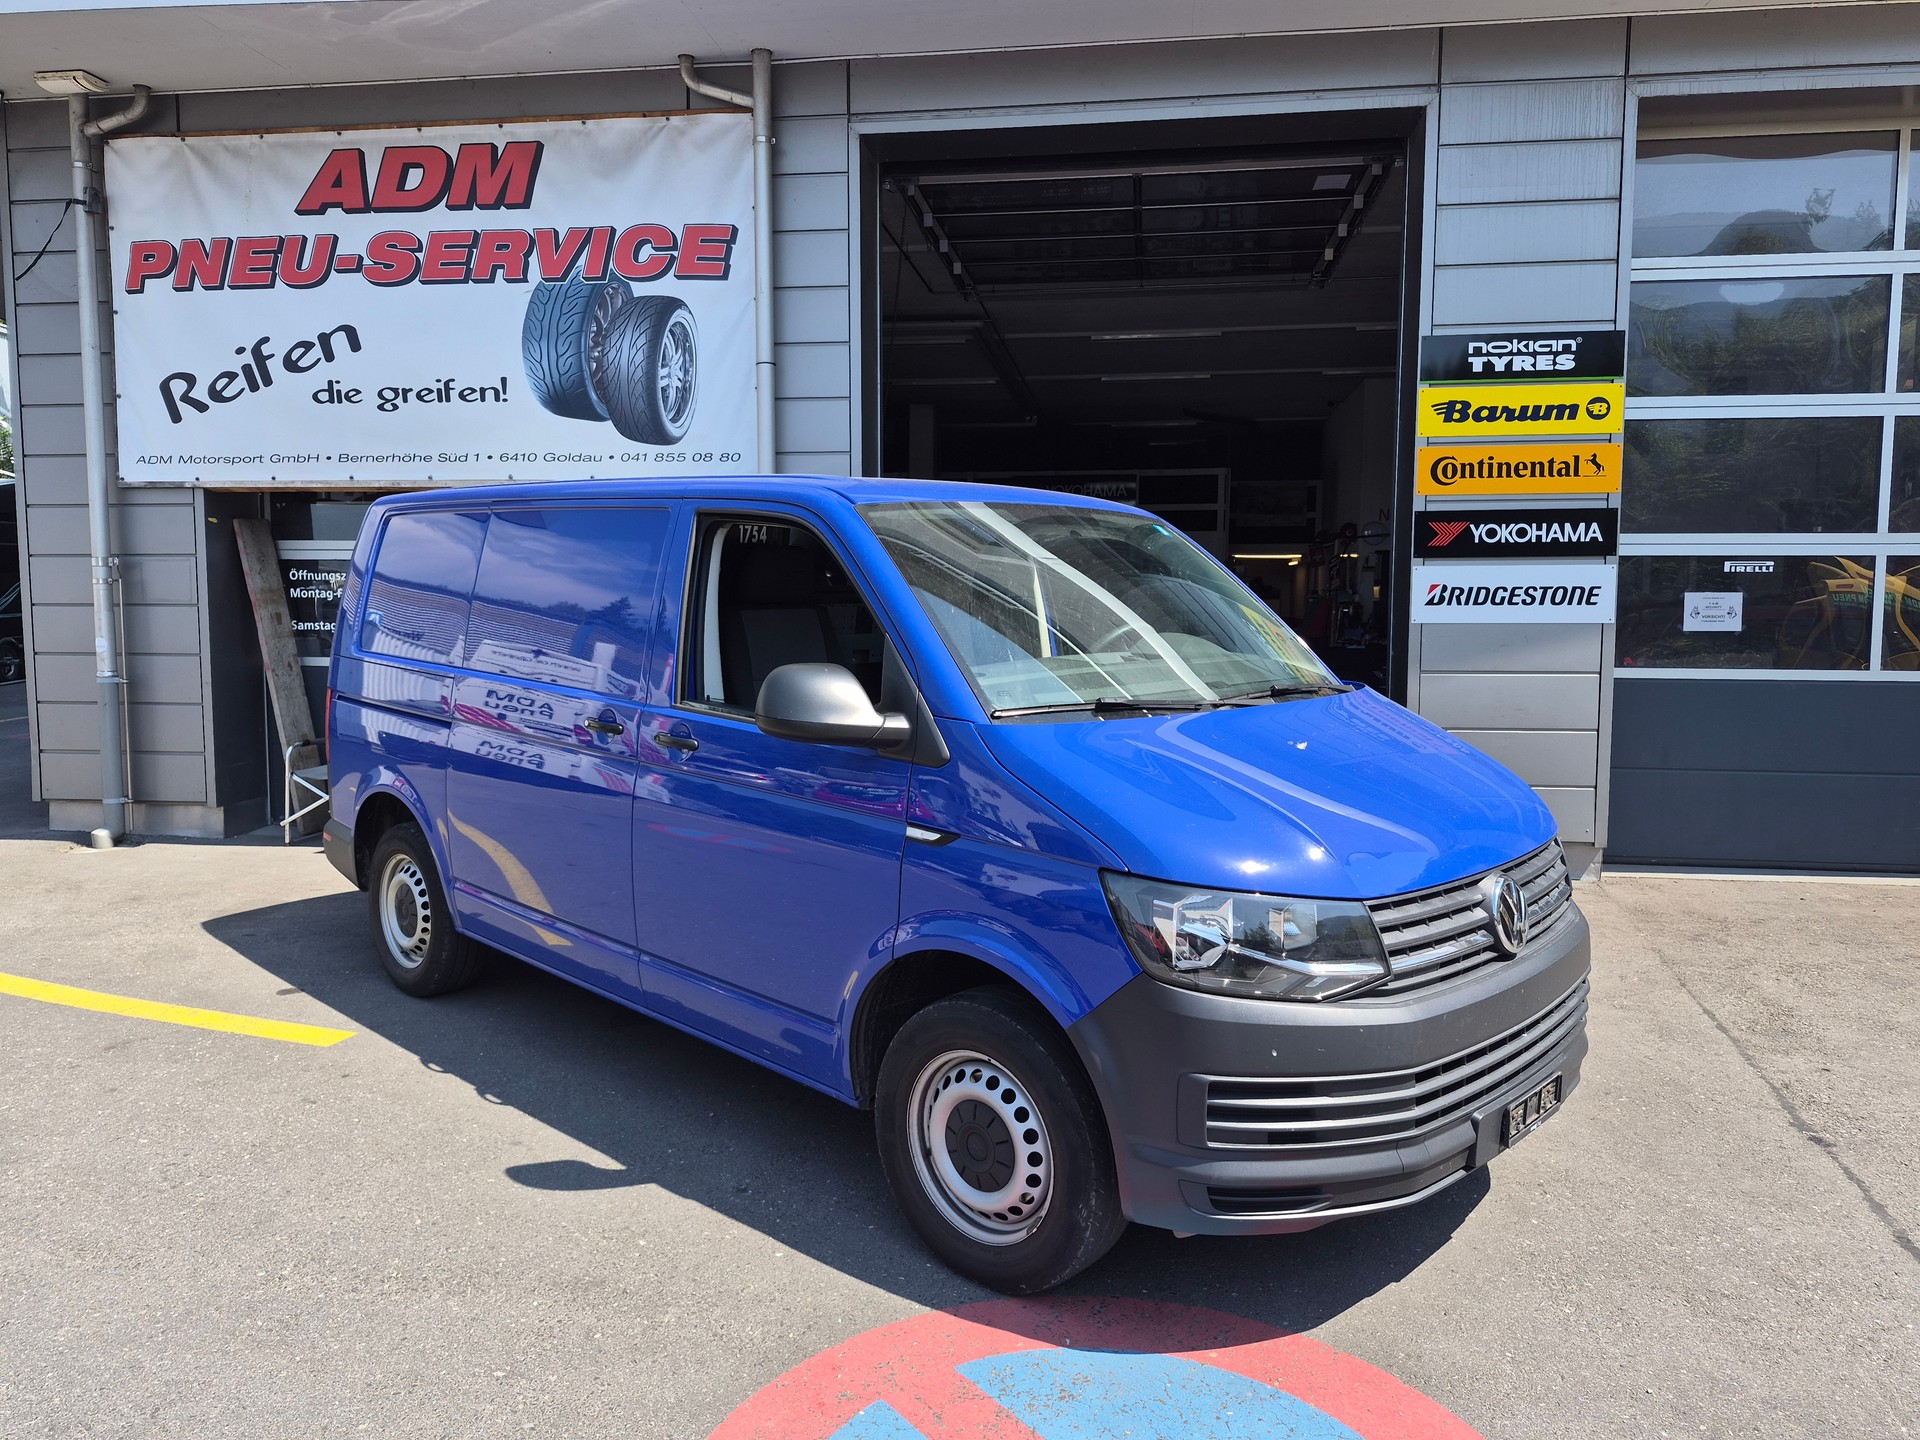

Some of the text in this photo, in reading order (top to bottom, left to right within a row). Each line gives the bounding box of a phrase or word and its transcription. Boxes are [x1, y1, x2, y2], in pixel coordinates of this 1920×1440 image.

[294, 140, 544, 216] ADM
[125, 223, 738, 294] PNEU-SERVICE
[159, 324, 362, 424] Reifen
[1468, 354, 1576, 373] TYRES
[312, 376, 509, 412] die greifen!
[1431, 400, 1580, 423] Barum
[136, 452, 742, 466] ADM Motorsport GmbH Bernerhöhe Süd 1 6410 Goldau 041 855 08 80
[1430, 455, 1581, 486] Continental
[739, 525, 767, 543] 1754
[1469, 522, 1604, 543] YOKOHAMA
[289, 568, 347, 584] Öffnungsz
[1724, 561, 1774, 572] PIRELLI
[1424, 584, 1602, 606] BRIDGESTONE
